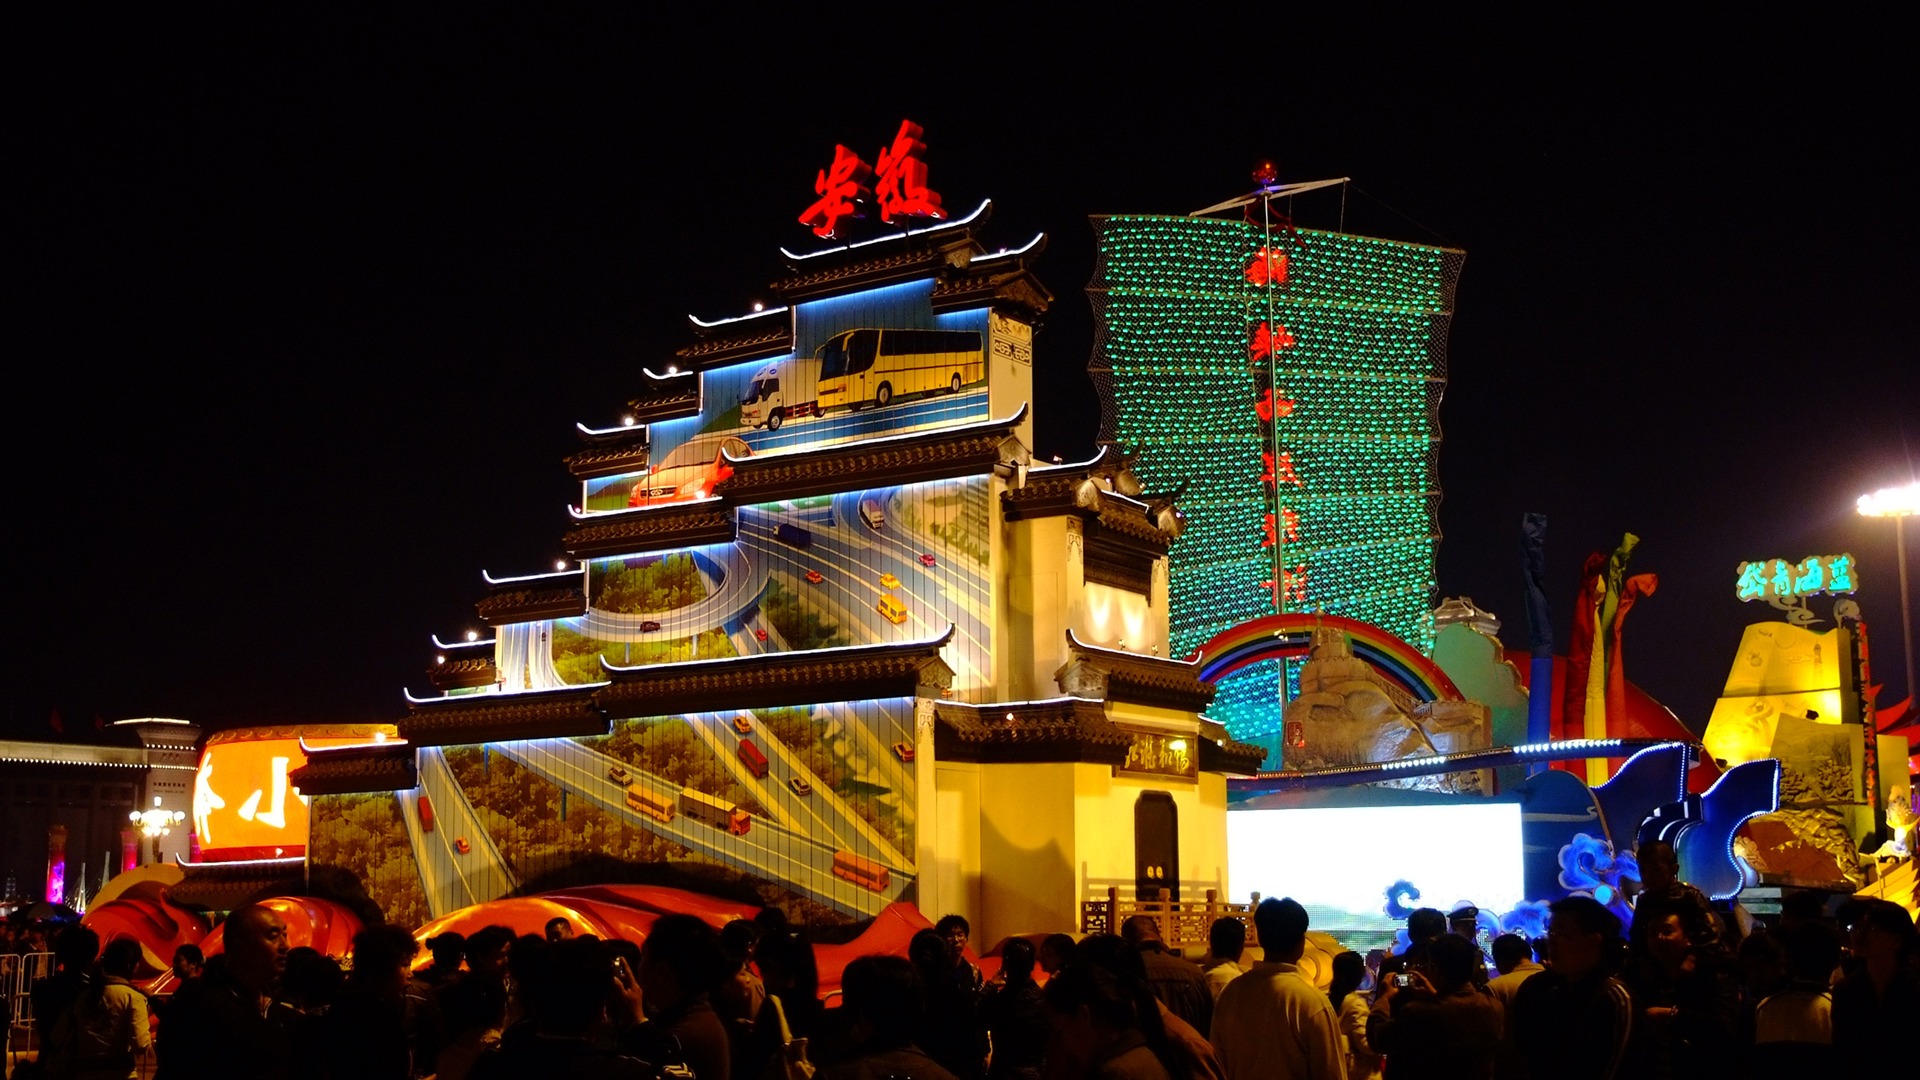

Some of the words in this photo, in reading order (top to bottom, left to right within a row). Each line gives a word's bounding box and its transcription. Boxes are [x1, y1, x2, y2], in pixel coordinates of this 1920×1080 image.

[798, 119, 948, 240] 安徽
[1737, 555, 1852, 598] 岱青海蓝
